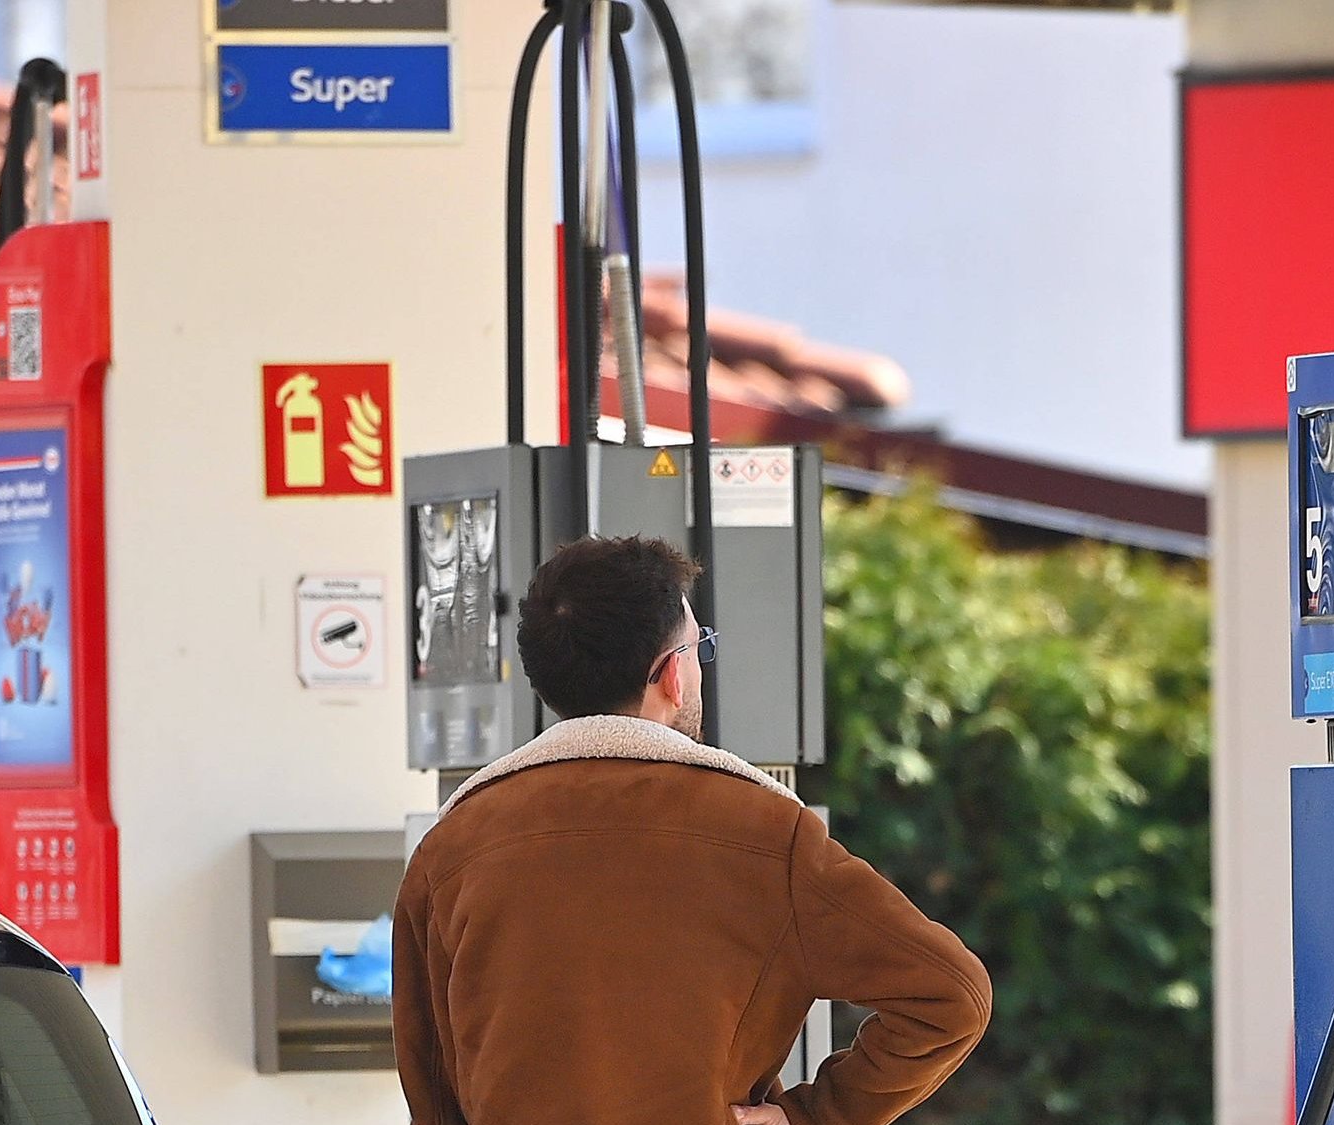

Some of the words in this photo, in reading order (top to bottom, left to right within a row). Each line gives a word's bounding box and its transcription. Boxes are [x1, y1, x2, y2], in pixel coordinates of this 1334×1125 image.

[290, 66, 395, 112] Super
[1306, 507, 1323, 593] 5
[416, 584, 432, 662] 3
